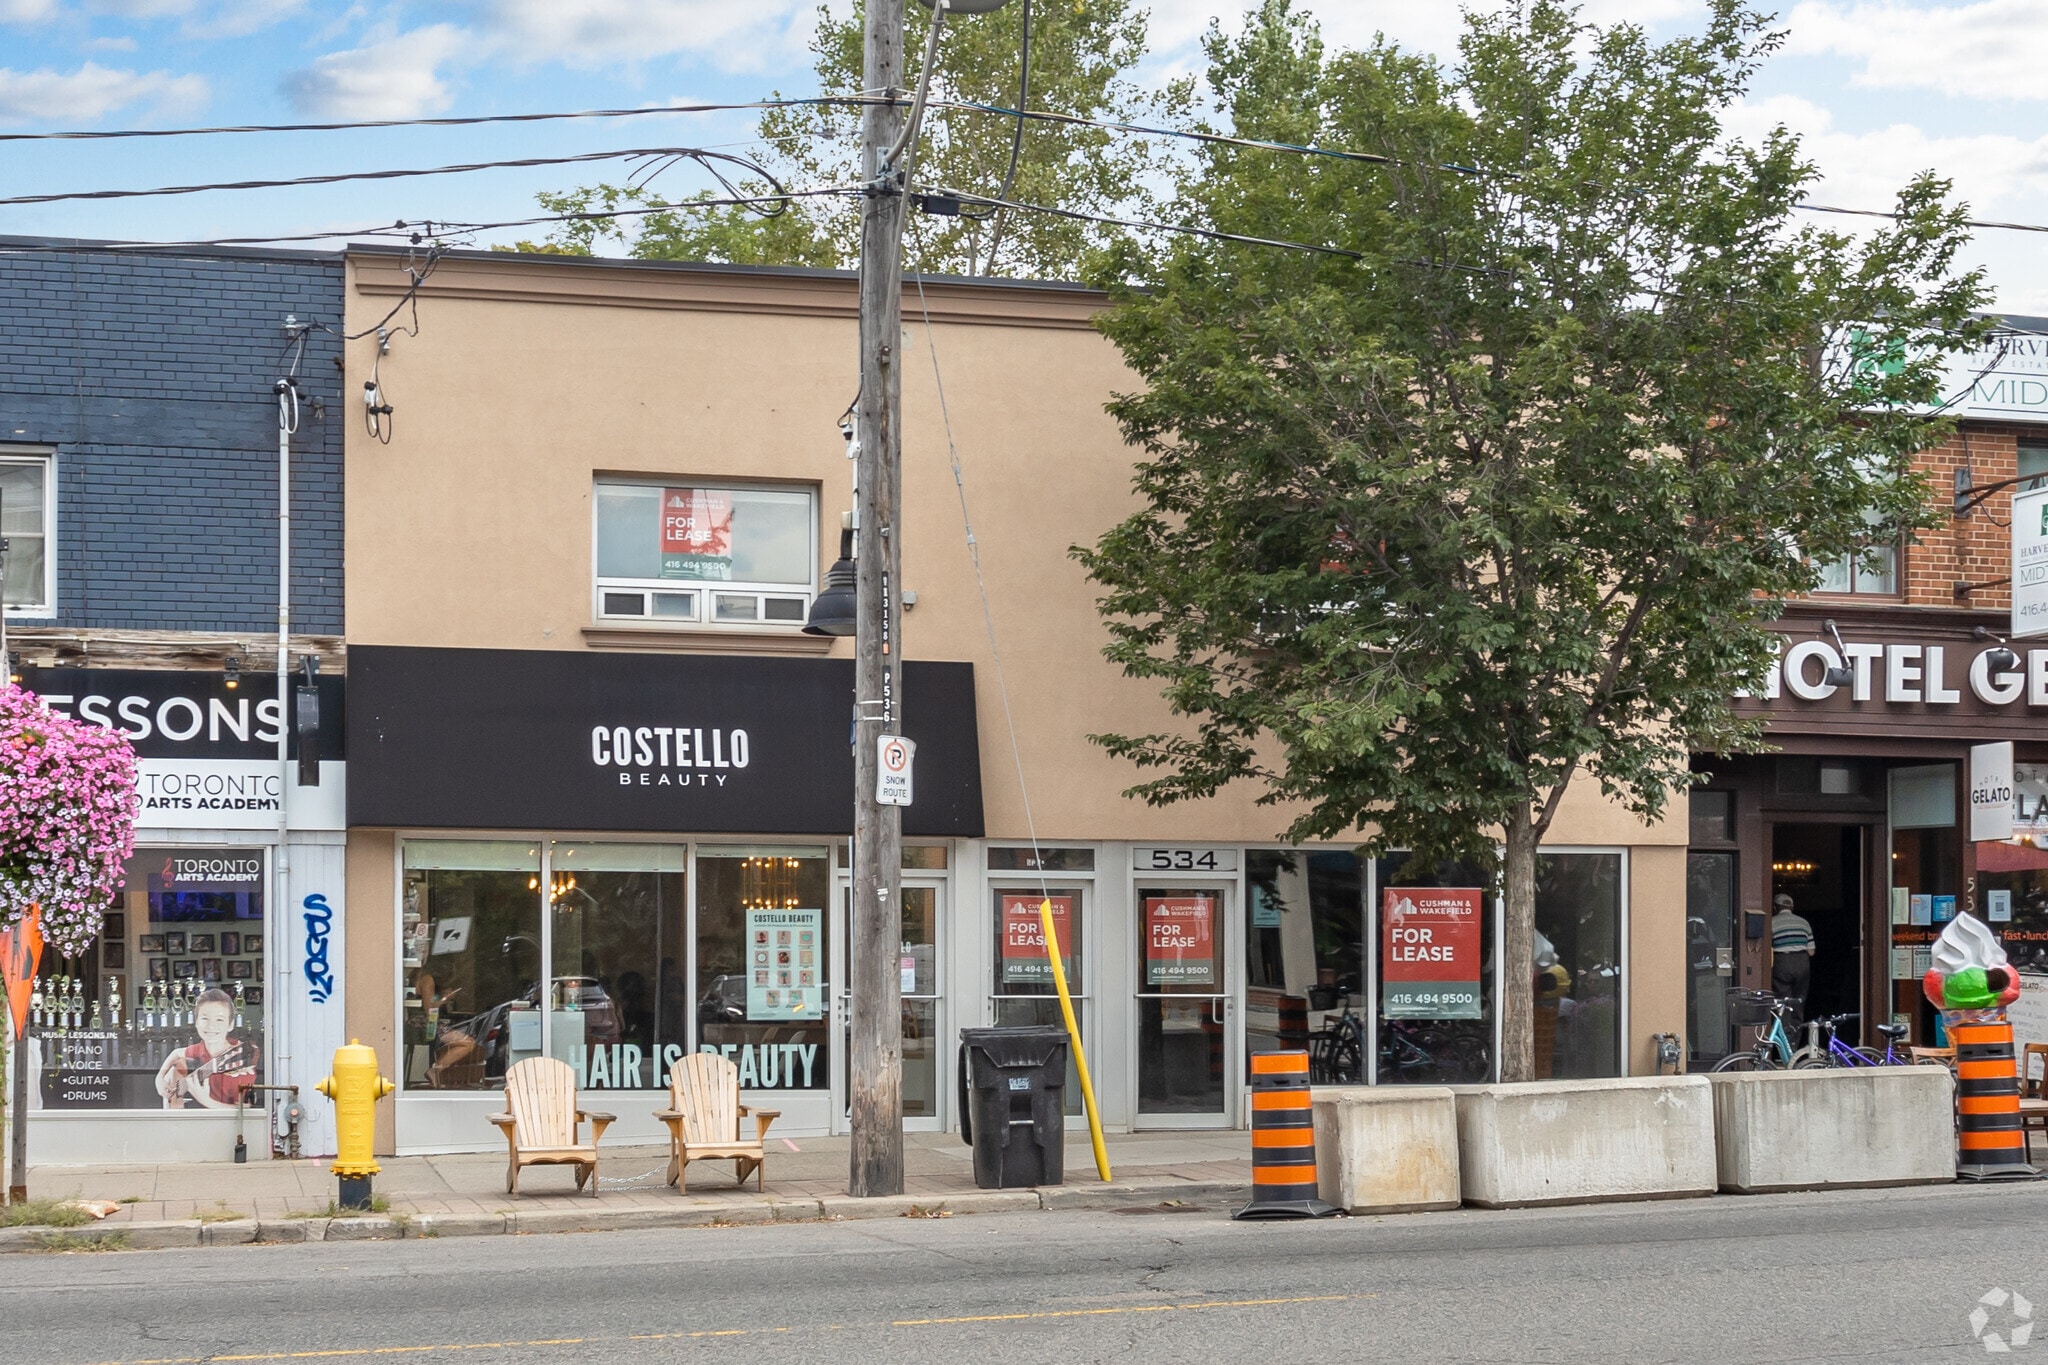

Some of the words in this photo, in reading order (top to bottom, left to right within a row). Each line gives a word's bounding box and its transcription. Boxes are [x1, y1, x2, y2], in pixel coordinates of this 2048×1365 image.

[1974, 336, 2048, 357] HARV
[2012, 361, 2048, 369] ESTA
[666, 517, 697, 528] FOR
[666, 530, 712, 541] LEASE
[665, 561, 681, 569] 416
[682, 561, 700, 569] 494
[702, 562, 726, 570] 9500
[2020, 564, 2048, 581] MID
[2020, 602, 2048, 616] 416.4
[591, 725, 749, 768] COSTELLO
[619, 773, 727, 786] BEAUTY
[886, 776, 906, 785] SNOW
[2014, 768, 2048, 783] OT
[146, 773, 279, 796] TORONTO
[883, 788, 907, 798] ROUTE
[1972, 787, 2011, 804] GELATO
[146, 797, 192, 809] ARTS
[197, 797, 279, 810] ACADEMY
[2012, 793, 2048, 821] LA
[1152, 850, 1218, 870] 534
[174, 859, 260, 873] TORONTO
[175, 873, 205, 881] ARTS
[206, 874, 260, 882] ACADEMY
[1420, 907, 1472, 915] WAKEFIELD
[754, 914, 786, 922] COSTELLO
[789, 914, 814, 922] BEAUTY
[1009, 923, 1038, 934] FOR
[1153, 924, 1181, 935] FOR
[1391, 928, 1433, 943] FOR
[1999, 930, 2022, 941] fast
[1153, 937, 1196, 948] LEASE
[1392, 946, 1454, 961] LEASE
[1007, 965, 1022, 973] 416
[1024, 965, 1041, 973] 494
[1043, 965, 1066, 973] 95
[1152, 967, 1166, 975] 416
[1168, 967, 1184, 975] 494
[1186, 967, 1209, 975] 9500
[1391, 994, 1412, 1004] 416
[1415, 994, 1439, 1004] 494
[1441, 994, 1473, 1004] 9500
[42, 1031, 67, 1039] MUSIC
[68, 1031, 103, 1039] LESSONS
[68, 1046, 103, 1055] PIANO
[68, 1060, 102, 1070] VOICE
[568, 1043, 642, 1088] HAIR
[653, 1043, 683, 1088] IS
[700, 1043, 818, 1088] AUTY
[68, 1075, 110, 1085] GUITAR
[68, 1091, 108, 1101] DRUMS
